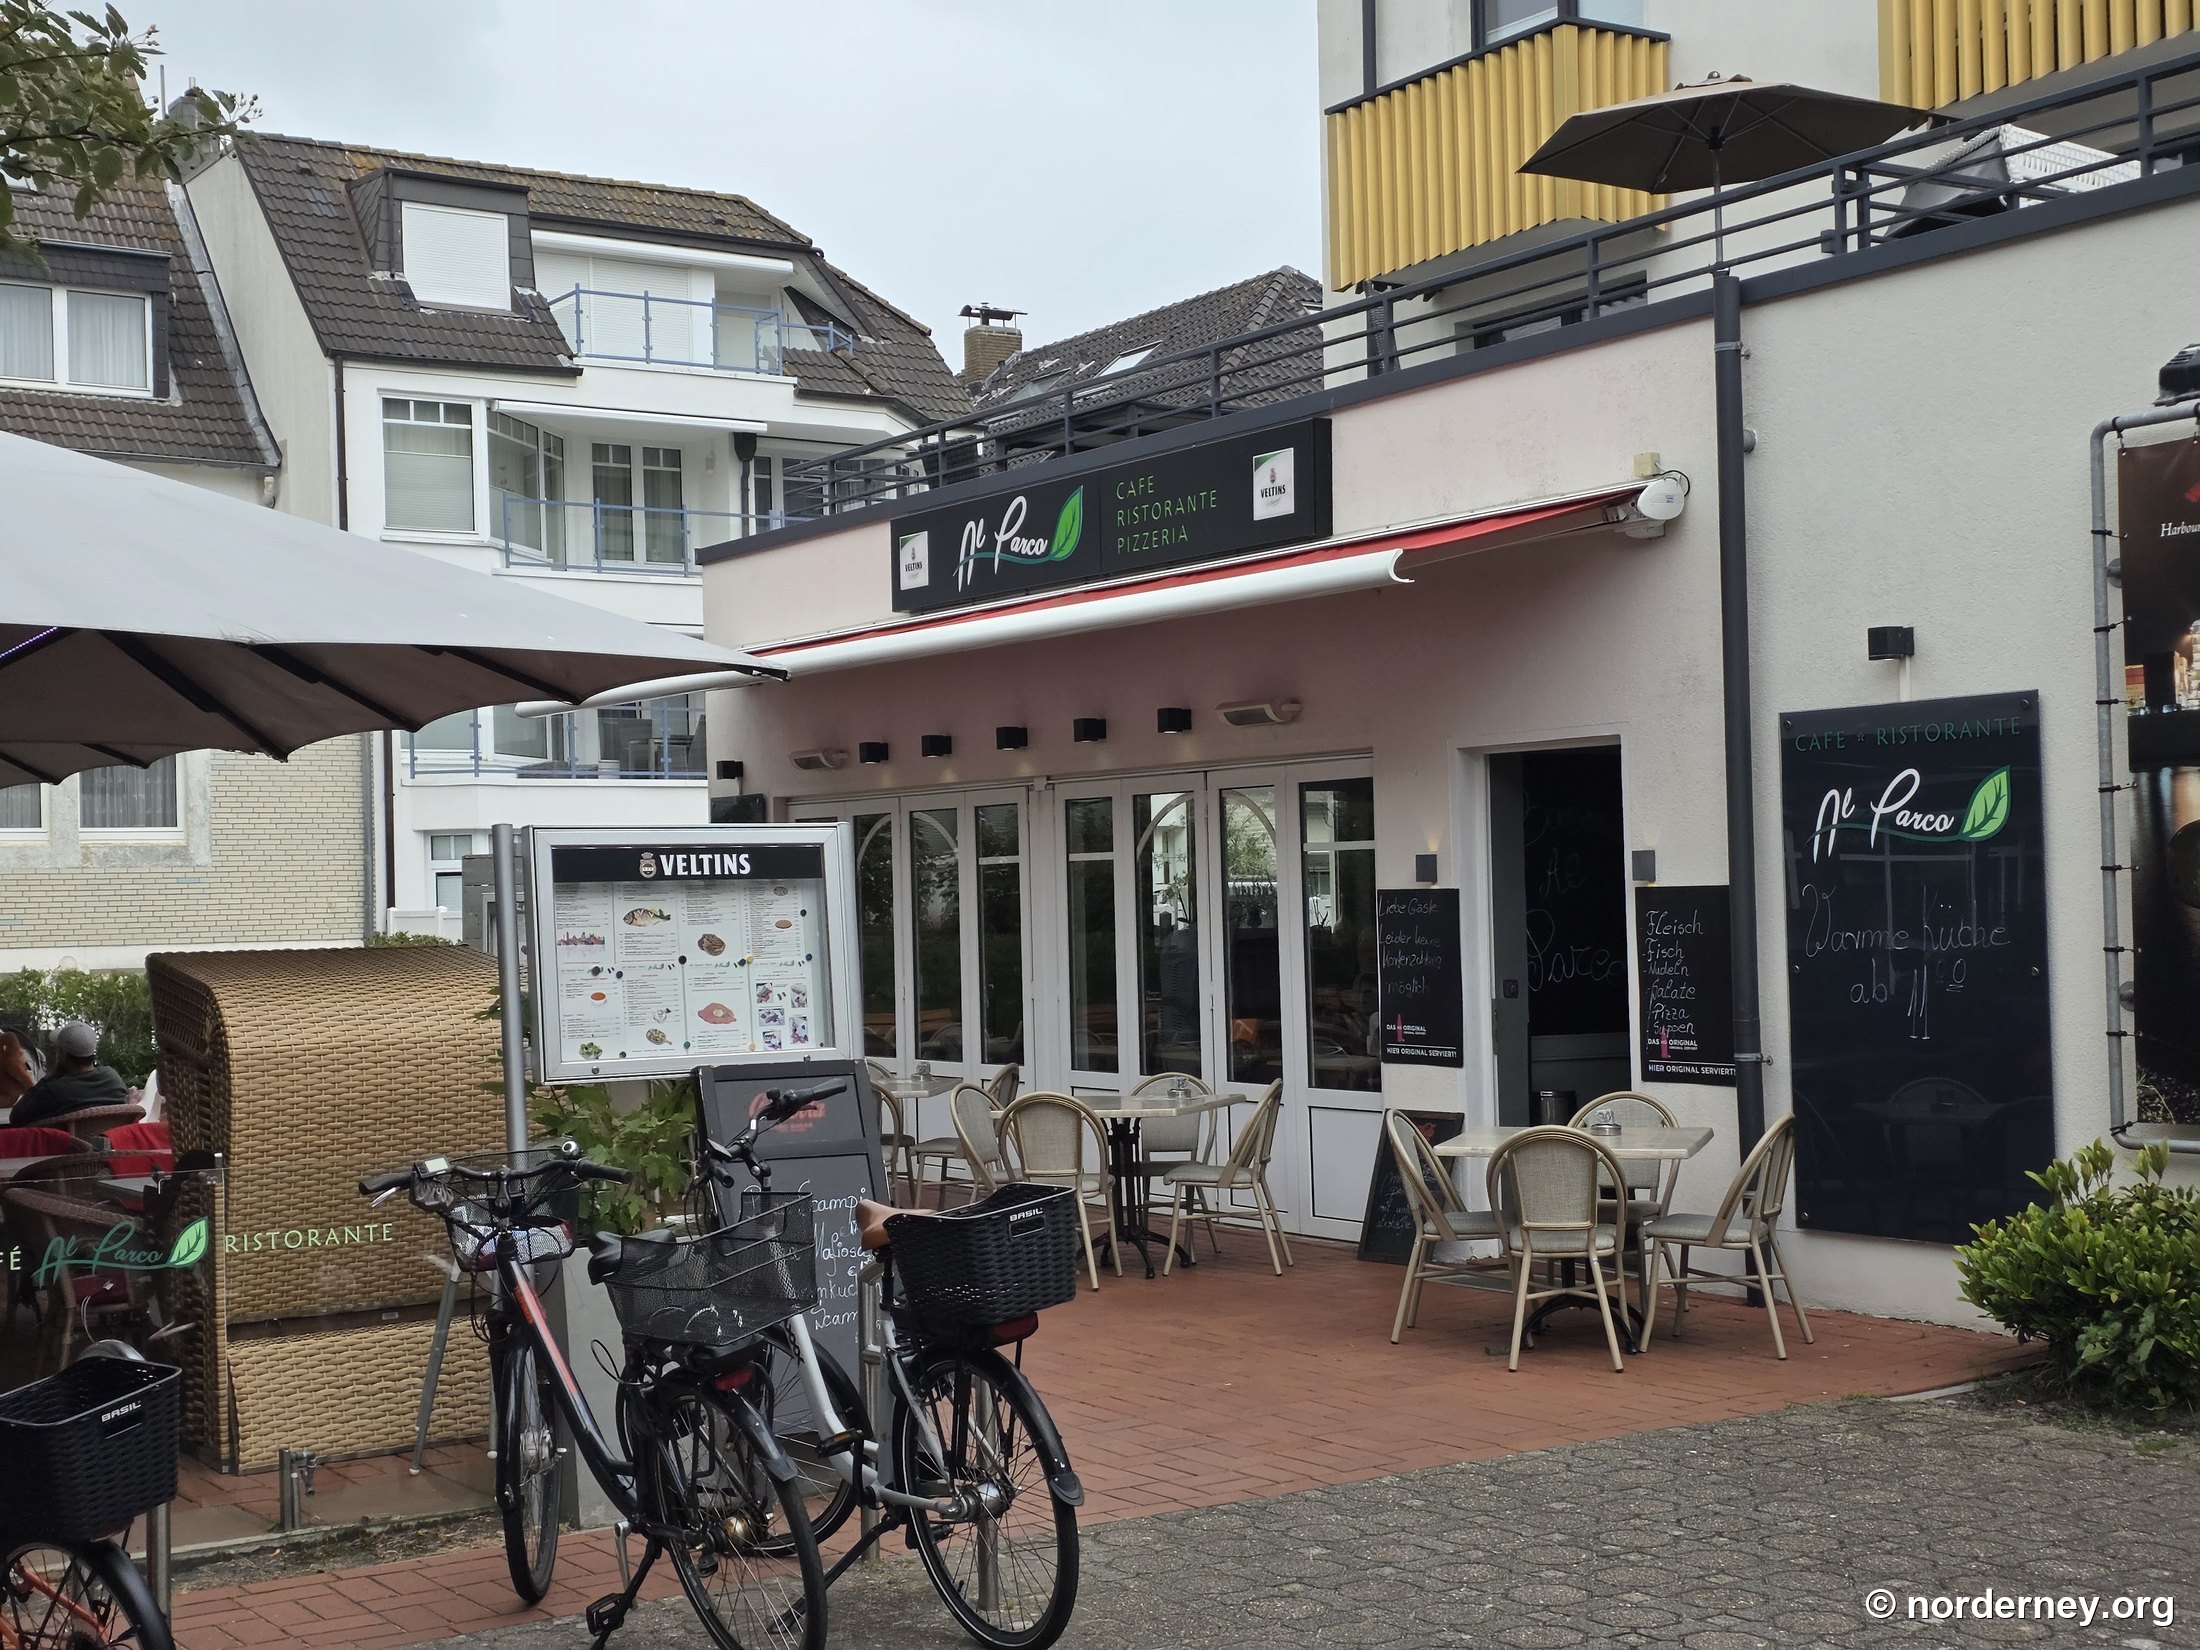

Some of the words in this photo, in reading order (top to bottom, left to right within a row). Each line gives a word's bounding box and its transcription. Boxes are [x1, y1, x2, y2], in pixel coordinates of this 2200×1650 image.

[1116, 475, 1155, 501] CAFE
[1260, 484, 1287, 499] VELTINS
[1117, 490, 1217, 527] RISTORANTE
[958, 517, 986, 593] Al
[994, 495, 1048, 575] Parco
[1117, 524, 1189, 555] PIZZERIA
[904, 561, 923, 573] VELTINS
[1795, 730, 1847, 752] CAFE
[1877, 715, 2021, 746] RISTORANTE
[1812, 787, 1856, 865] Al
[1869, 768, 1955, 849] Parco
[659, 853, 751, 876] VELTINS
[1646, 909, 1704, 936] Fleisch
[1645, 937, 1685, 962] Fisch
[1648, 958, 1689, 977] Nudeln
[1650, 978, 1696, 1001] Salate
[1850, 958, 1888, 1004] ab
[1651, 1002, 1690, 1021] Pizza
[1402, 1025, 1427, 1033] ORIGINAL
[1400, 1048, 1428, 1057] ORIGINAL
[1647, 1038, 1660, 1046] DAS
[1668, 1039, 1698, 1048] ORIGINAL
[1648, 1064, 1665, 1073] HIER
[1666, 1065, 1700, 1075] ORIGINAL
[1009, 1208, 1043, 1222] BASIL
[91, 1220, 163, 1275] Parco
[225, 1222, 394, 1255] RISTORANTE
[101, 1401, 142, 1423] BASIL
